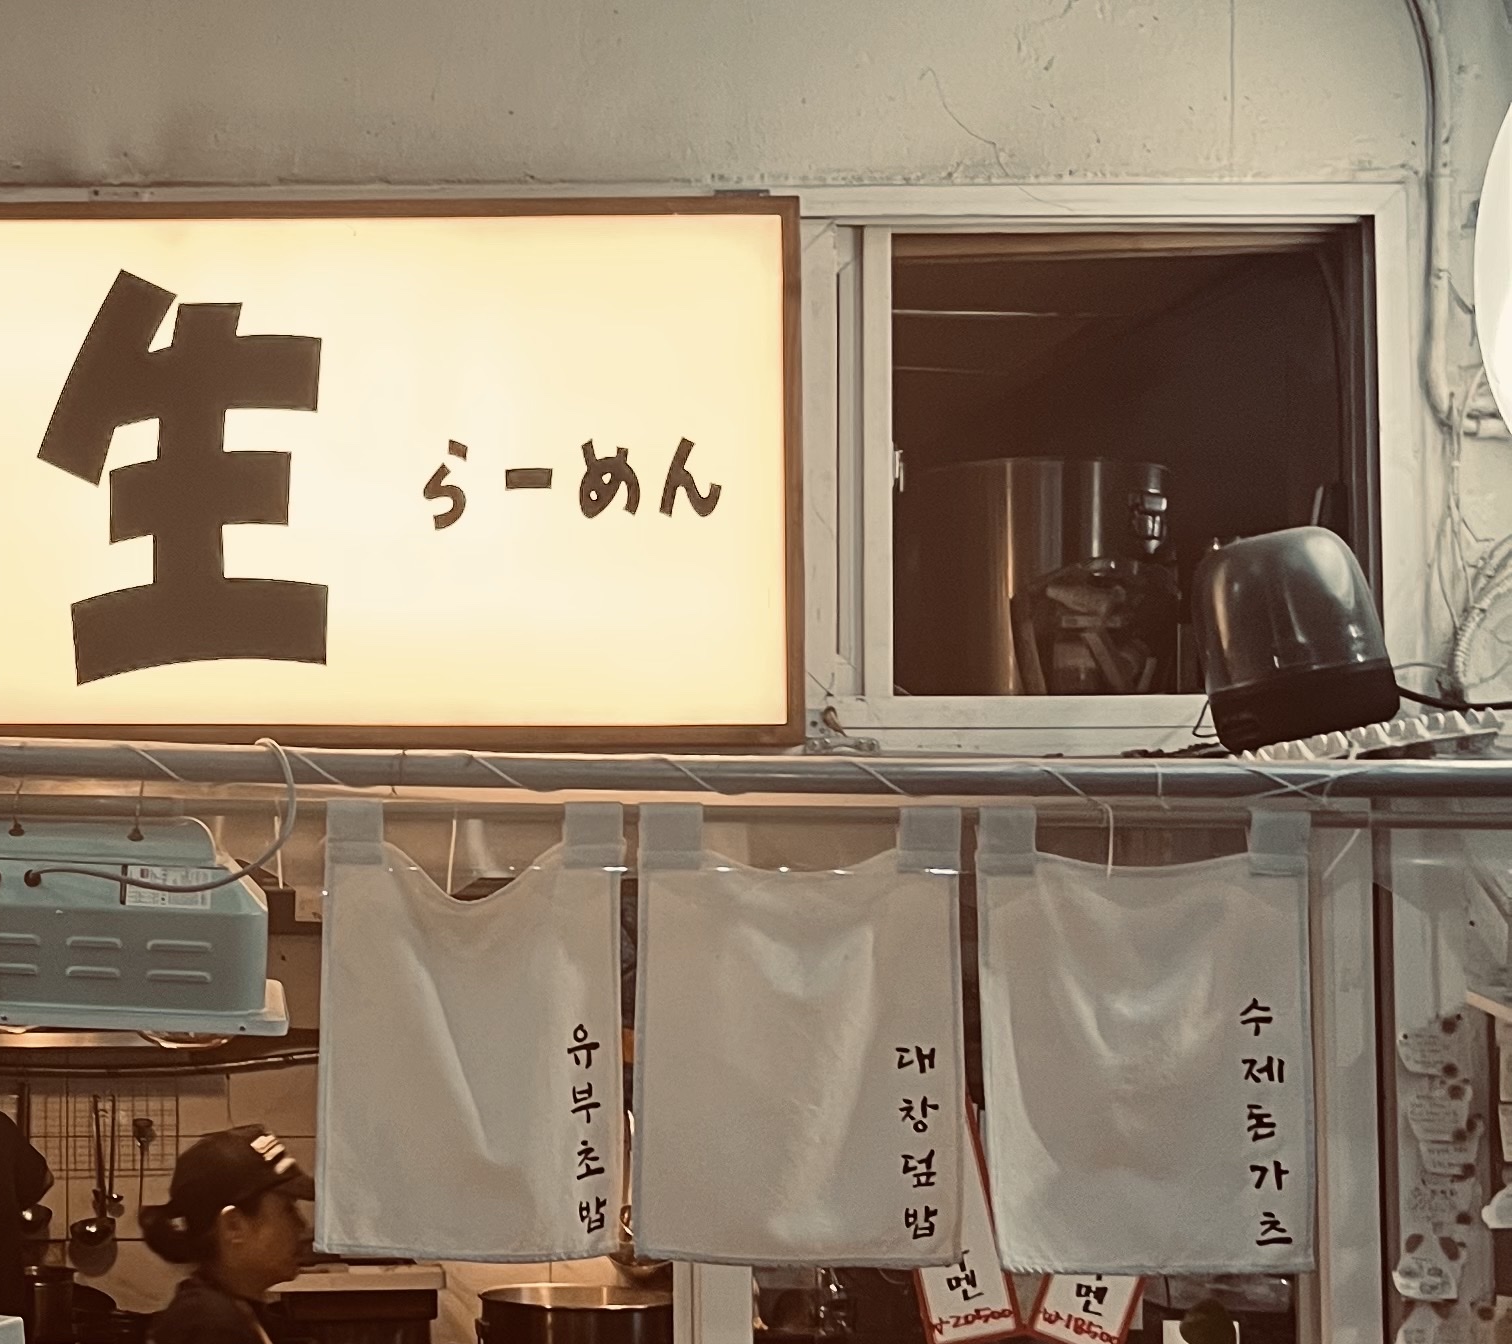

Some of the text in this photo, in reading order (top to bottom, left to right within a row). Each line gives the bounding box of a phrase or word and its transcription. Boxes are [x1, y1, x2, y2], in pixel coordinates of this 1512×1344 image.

[424, 438, 721, 529] らーめん
[567, 1024, 606, 1233] 유부초밥
[895, 1046, 939, 1239] 대창덮밥
[1240, 998, 1292, 1246] 수제돈가츠
